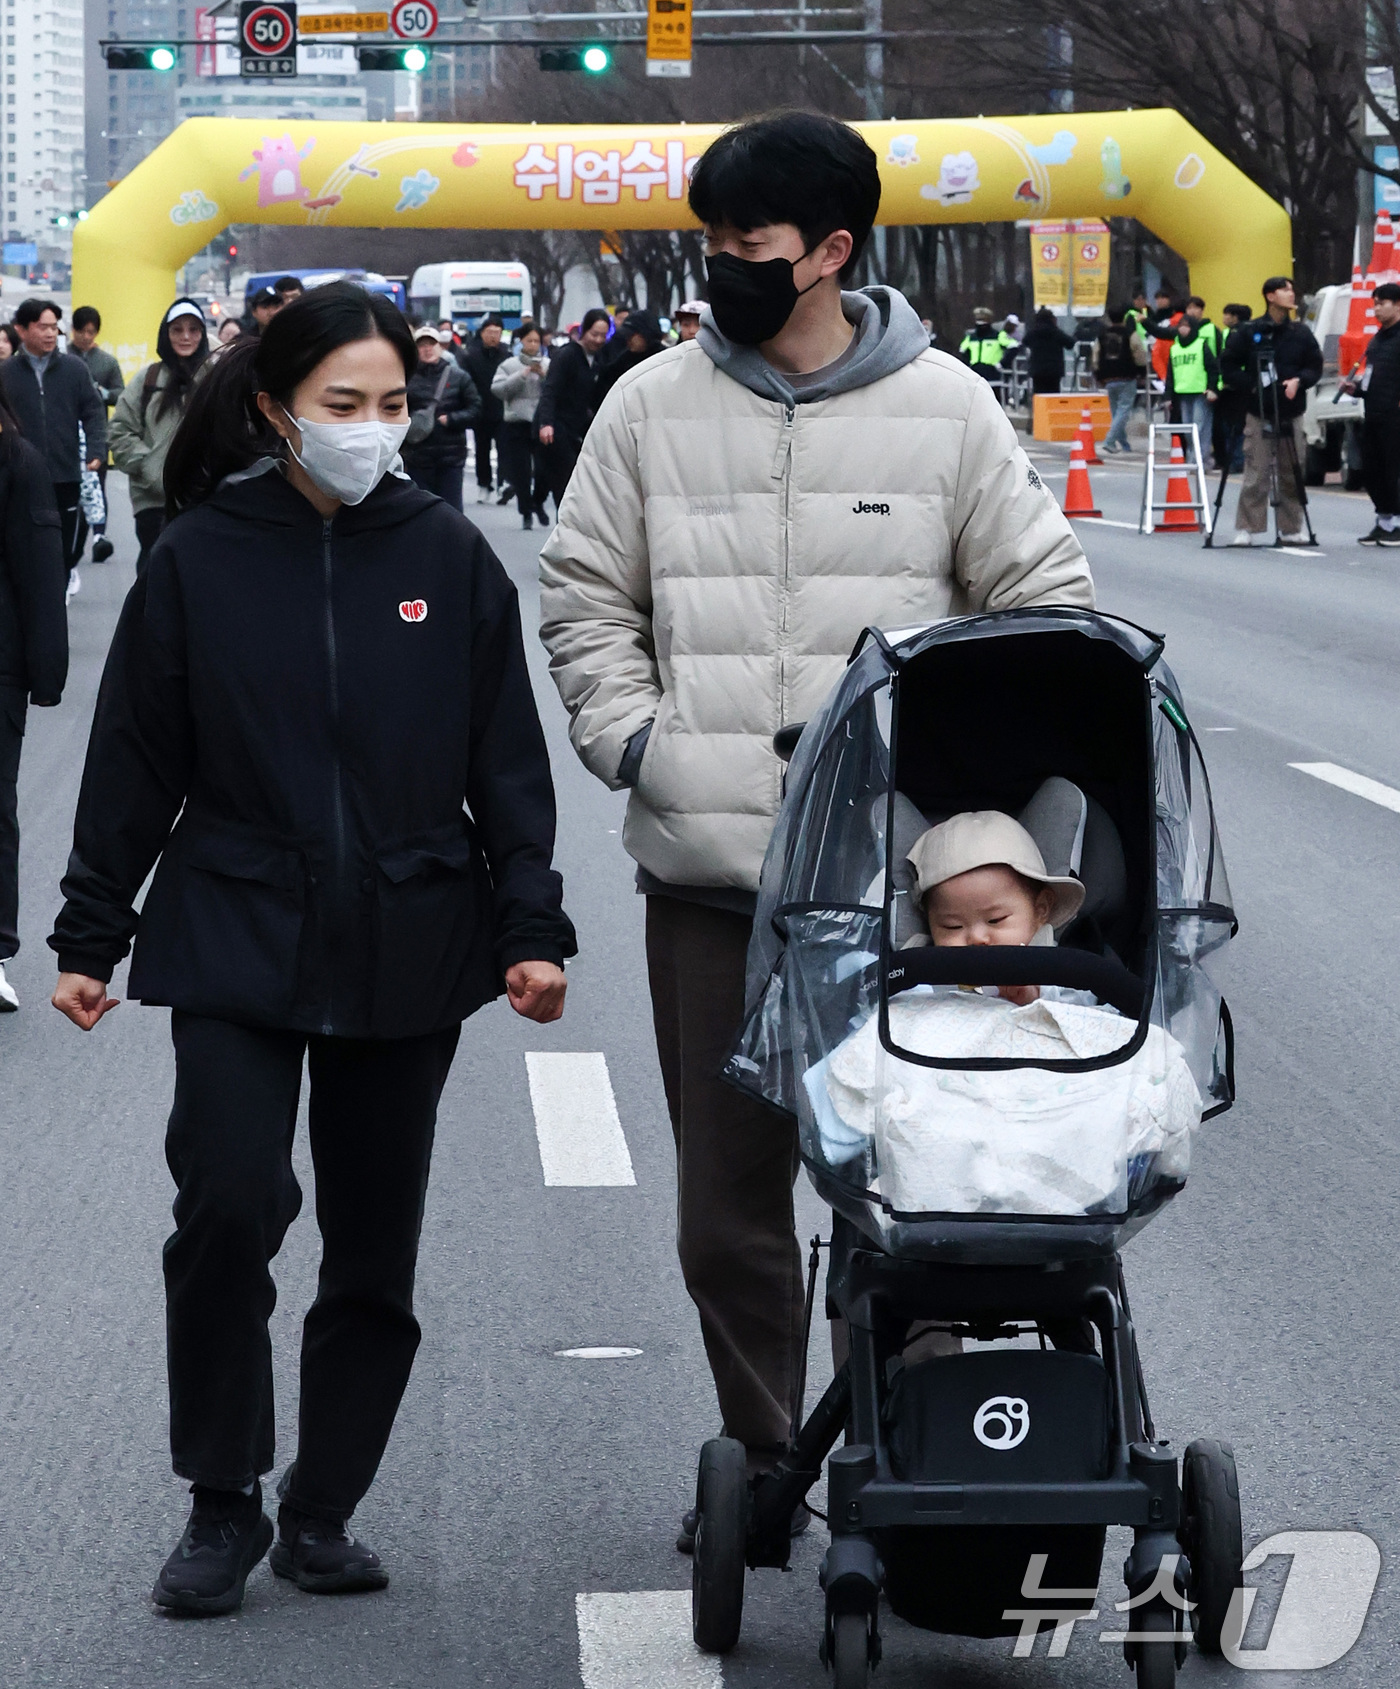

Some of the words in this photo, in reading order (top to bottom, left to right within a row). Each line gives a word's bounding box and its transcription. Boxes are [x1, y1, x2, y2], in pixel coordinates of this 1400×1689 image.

[254, 19, 284, 42] 50
[403, 8, 428, 31] 50
[513, 140, 700, 205] 쉬엄쉬
[852, 500, 890, 516] Jeep
[401, 602, 425, 620] NIKE
